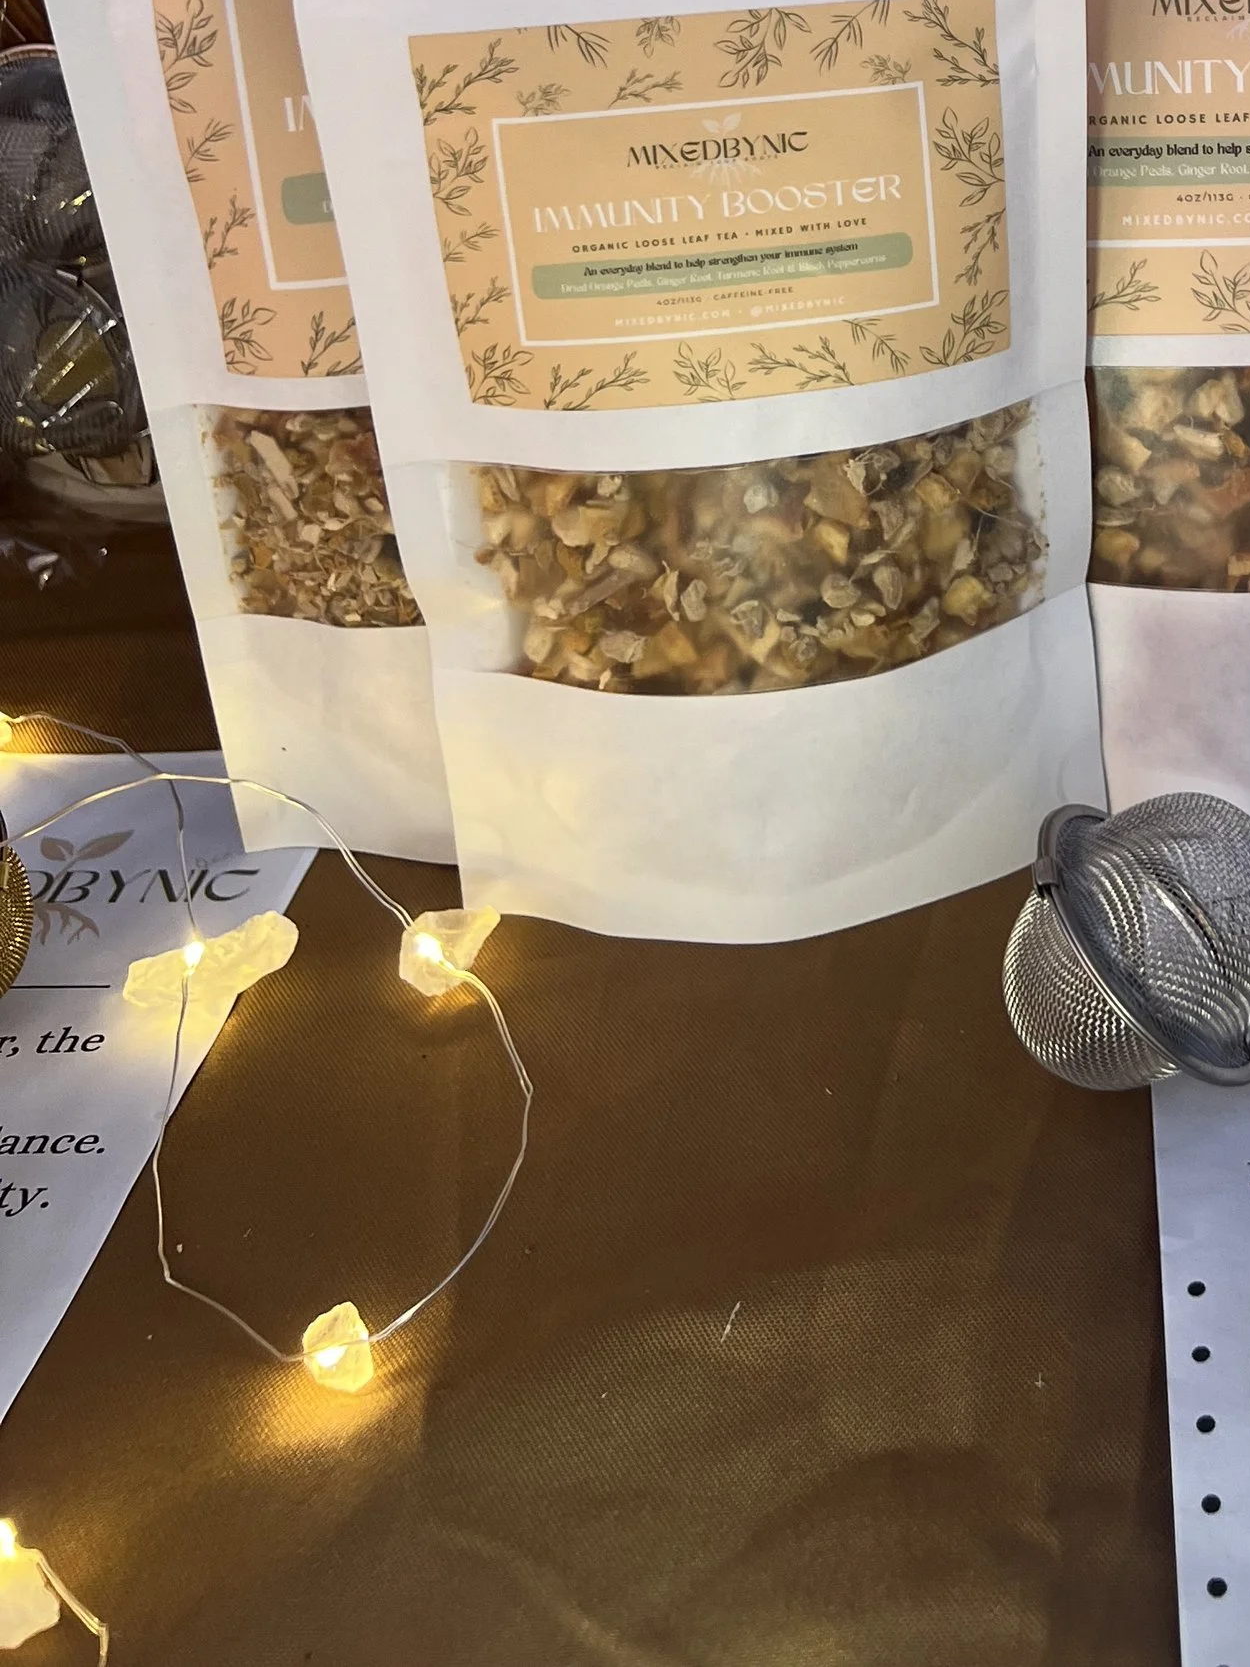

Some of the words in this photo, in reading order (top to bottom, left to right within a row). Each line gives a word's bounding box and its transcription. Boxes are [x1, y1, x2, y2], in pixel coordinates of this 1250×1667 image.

[1156, 114, 1206, 124] LOOSE
[1215, 113, 1250, 123] LEAF
[626, 131, 808, 168] MIXEDBYNIC
[1088, 145, 1105, 157] An
[1108, 145, 1163, 159] everyday
[1167, 142, 1199, 156] blend
[1202, 144, 1214, 155] to
[1216, 142, 1242, 157] help
[1178, 164, 1216, 178] Ginger
[533, 193, 711, 232] IMMUNITY
[722, 174, 901, 218] BOOSTER
[1177, 191, 1234, 202] 4OZ/113G
[572, 241, 628, 253] ORGANIC
[636, 237, 675, 248] LOOSE
[682, 234, 709, 244] LEAF
[717, 232, 738, 241] TEA
[756, 226, 793, 237] MIXED
[800, 222, 831, 232] WITH
[838, 218, 867, 228] LOVE
[36, 1026, 105, 1054] the
